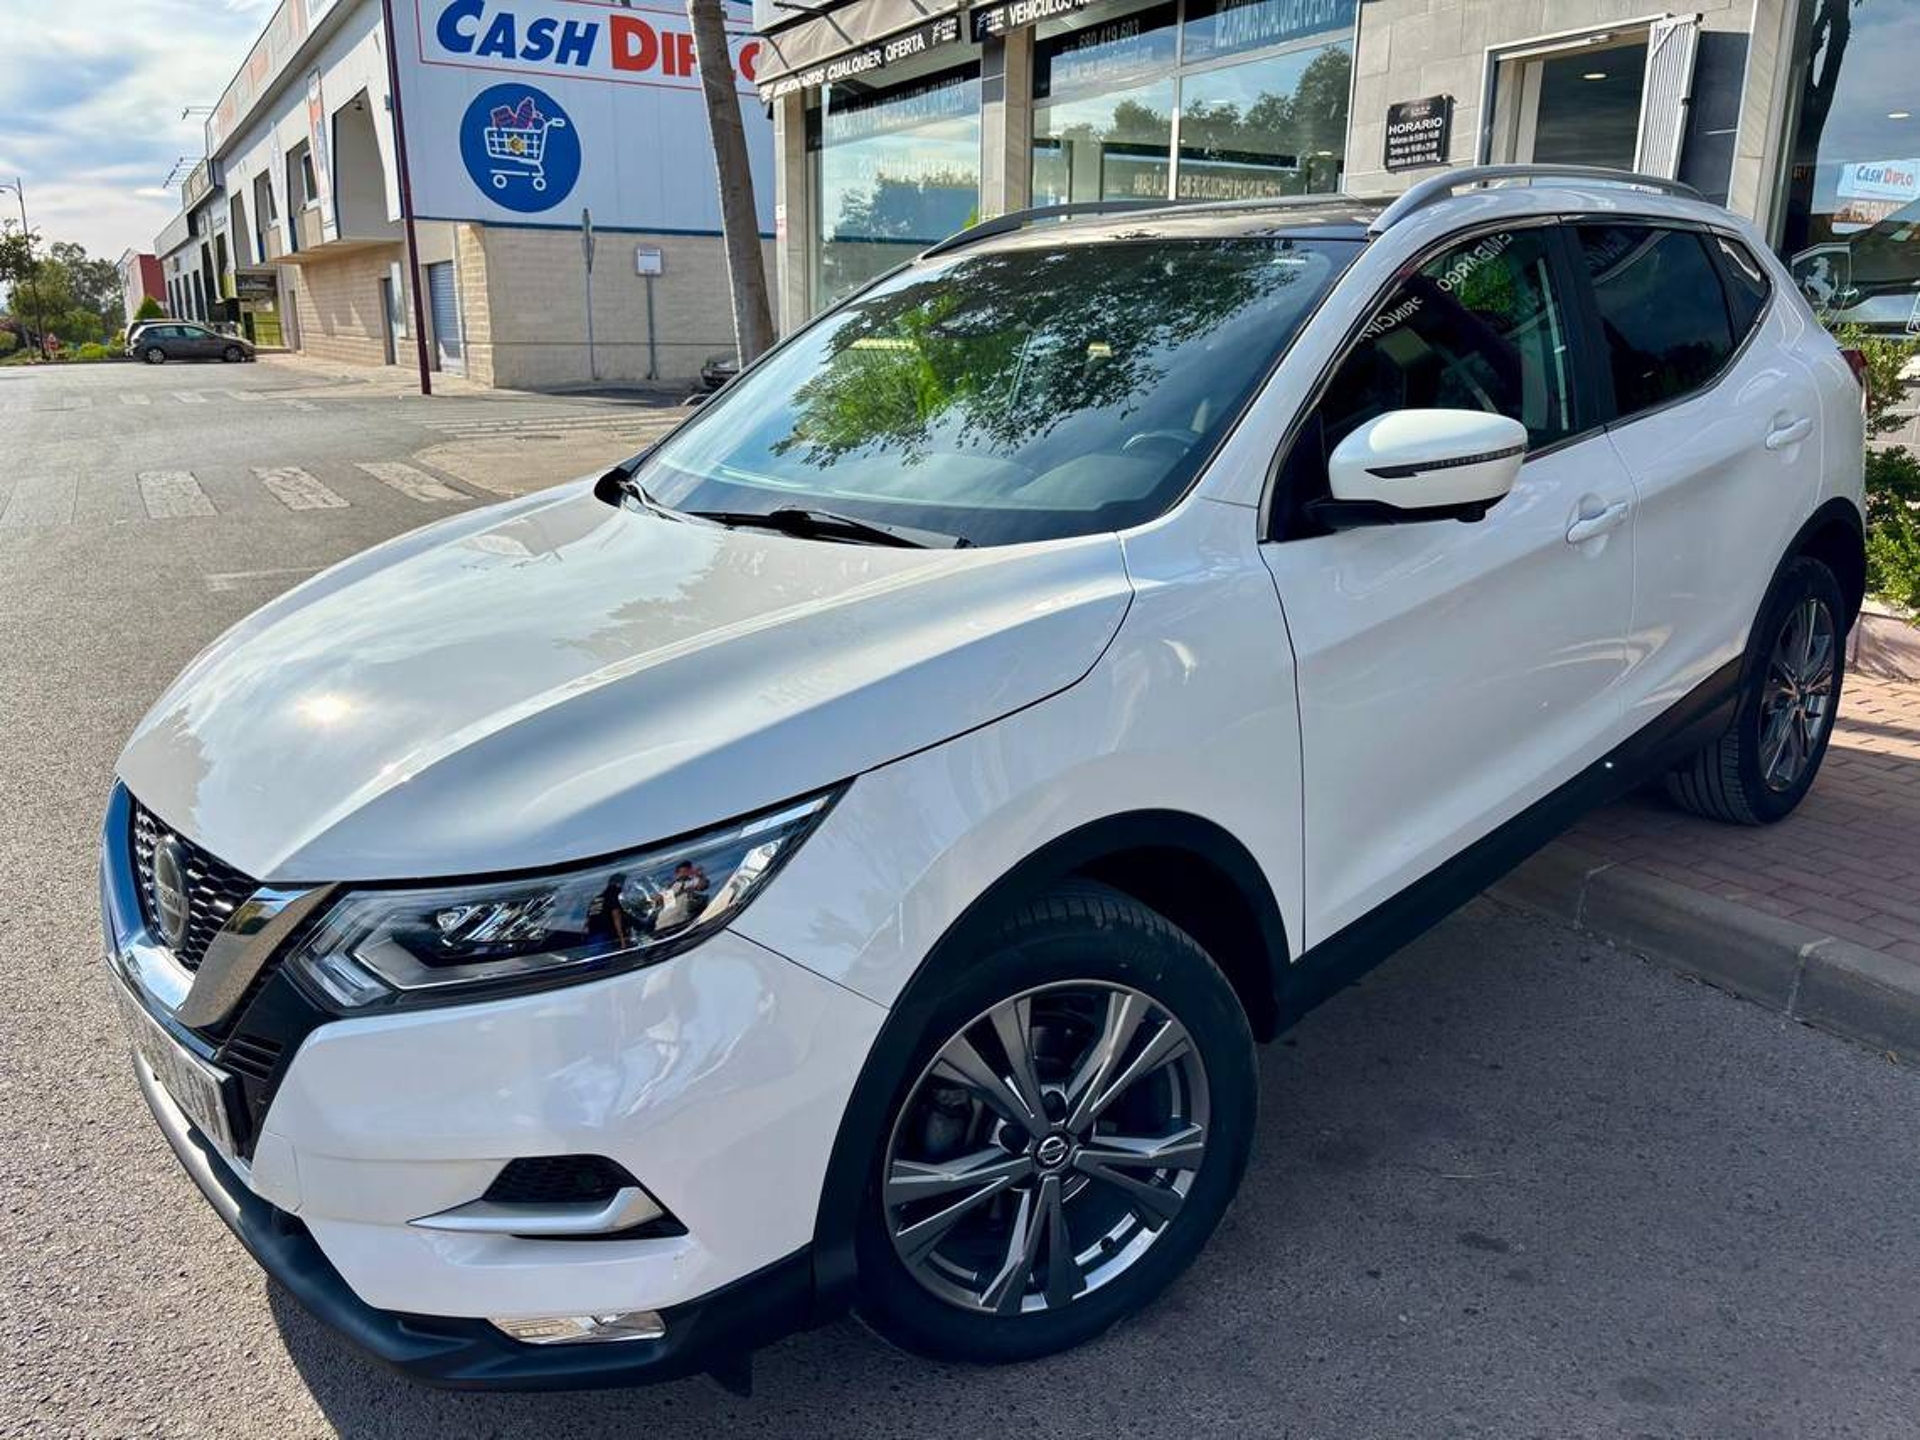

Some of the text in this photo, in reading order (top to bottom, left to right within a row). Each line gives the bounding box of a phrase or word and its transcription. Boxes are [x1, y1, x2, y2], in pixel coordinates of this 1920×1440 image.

[436, 0, 760, 83] CASH DIPO
[827, 50, 882, 80] CUALQUIER
[885, 33, 926, 62] OFERTA
[1388, 117, 1443, 135] HORARIO
